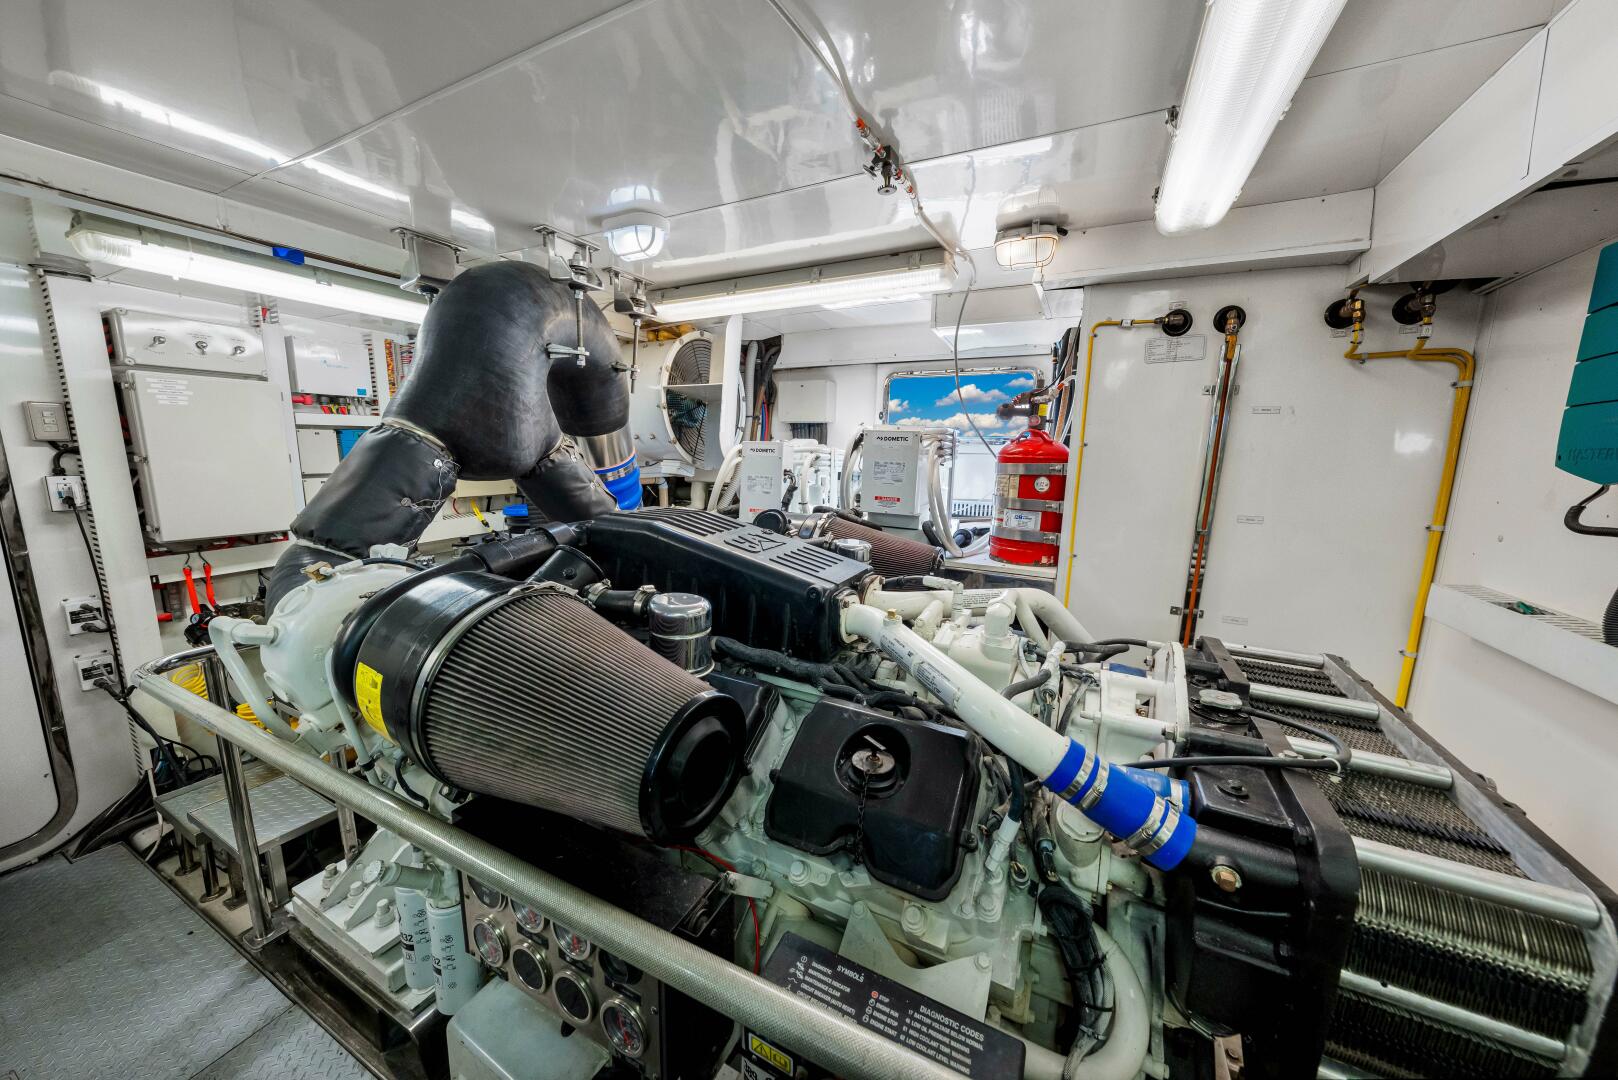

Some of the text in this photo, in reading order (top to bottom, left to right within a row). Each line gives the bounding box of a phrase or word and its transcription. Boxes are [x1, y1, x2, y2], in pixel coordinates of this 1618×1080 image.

[808, 969, 850, 992] MAINTENANCE INDICATOR
[837, 965, 864, 982] SYMBOLS
[801, 983, 814, 993] CIRCUIT
[814, 990, 831, 1002] BREAKER
[828, 988, 841, 997] CLEAR
[878, 994, 890, 1003] STOP
[875, 1002, 890, 1014] ENGINE
[869, 1019, 898, 1037] ENGINE START
[873, 1010, 899, 1027] ENGINE STOP
[920, 1005, 985, 1042] DIAGNOSTIC CODES
[909, 1029, 920, 1038] HIGH
[919, 1034, 939, 1048] COOLANT
[911, 1020, 921, 1029] LOW
[928, 1029, 951, 1044] PRESSURE
[950, 1040, 970, 1054] WARNING
[913, 1012, 932, 1025] BATTERY
[931, 1021, 951, 1035] VOLTAGE
[950, 1030, 966, 1042] BELOW
[965, 1037, 984, 1051] NORMAL
[906, 1037, 916, 1046] LOW
[916, 1042, 936, 1057] COOLANT
[935, 1052, 950, 1065] LEVEL
[950, 1059, 970, 1075] WARNING
